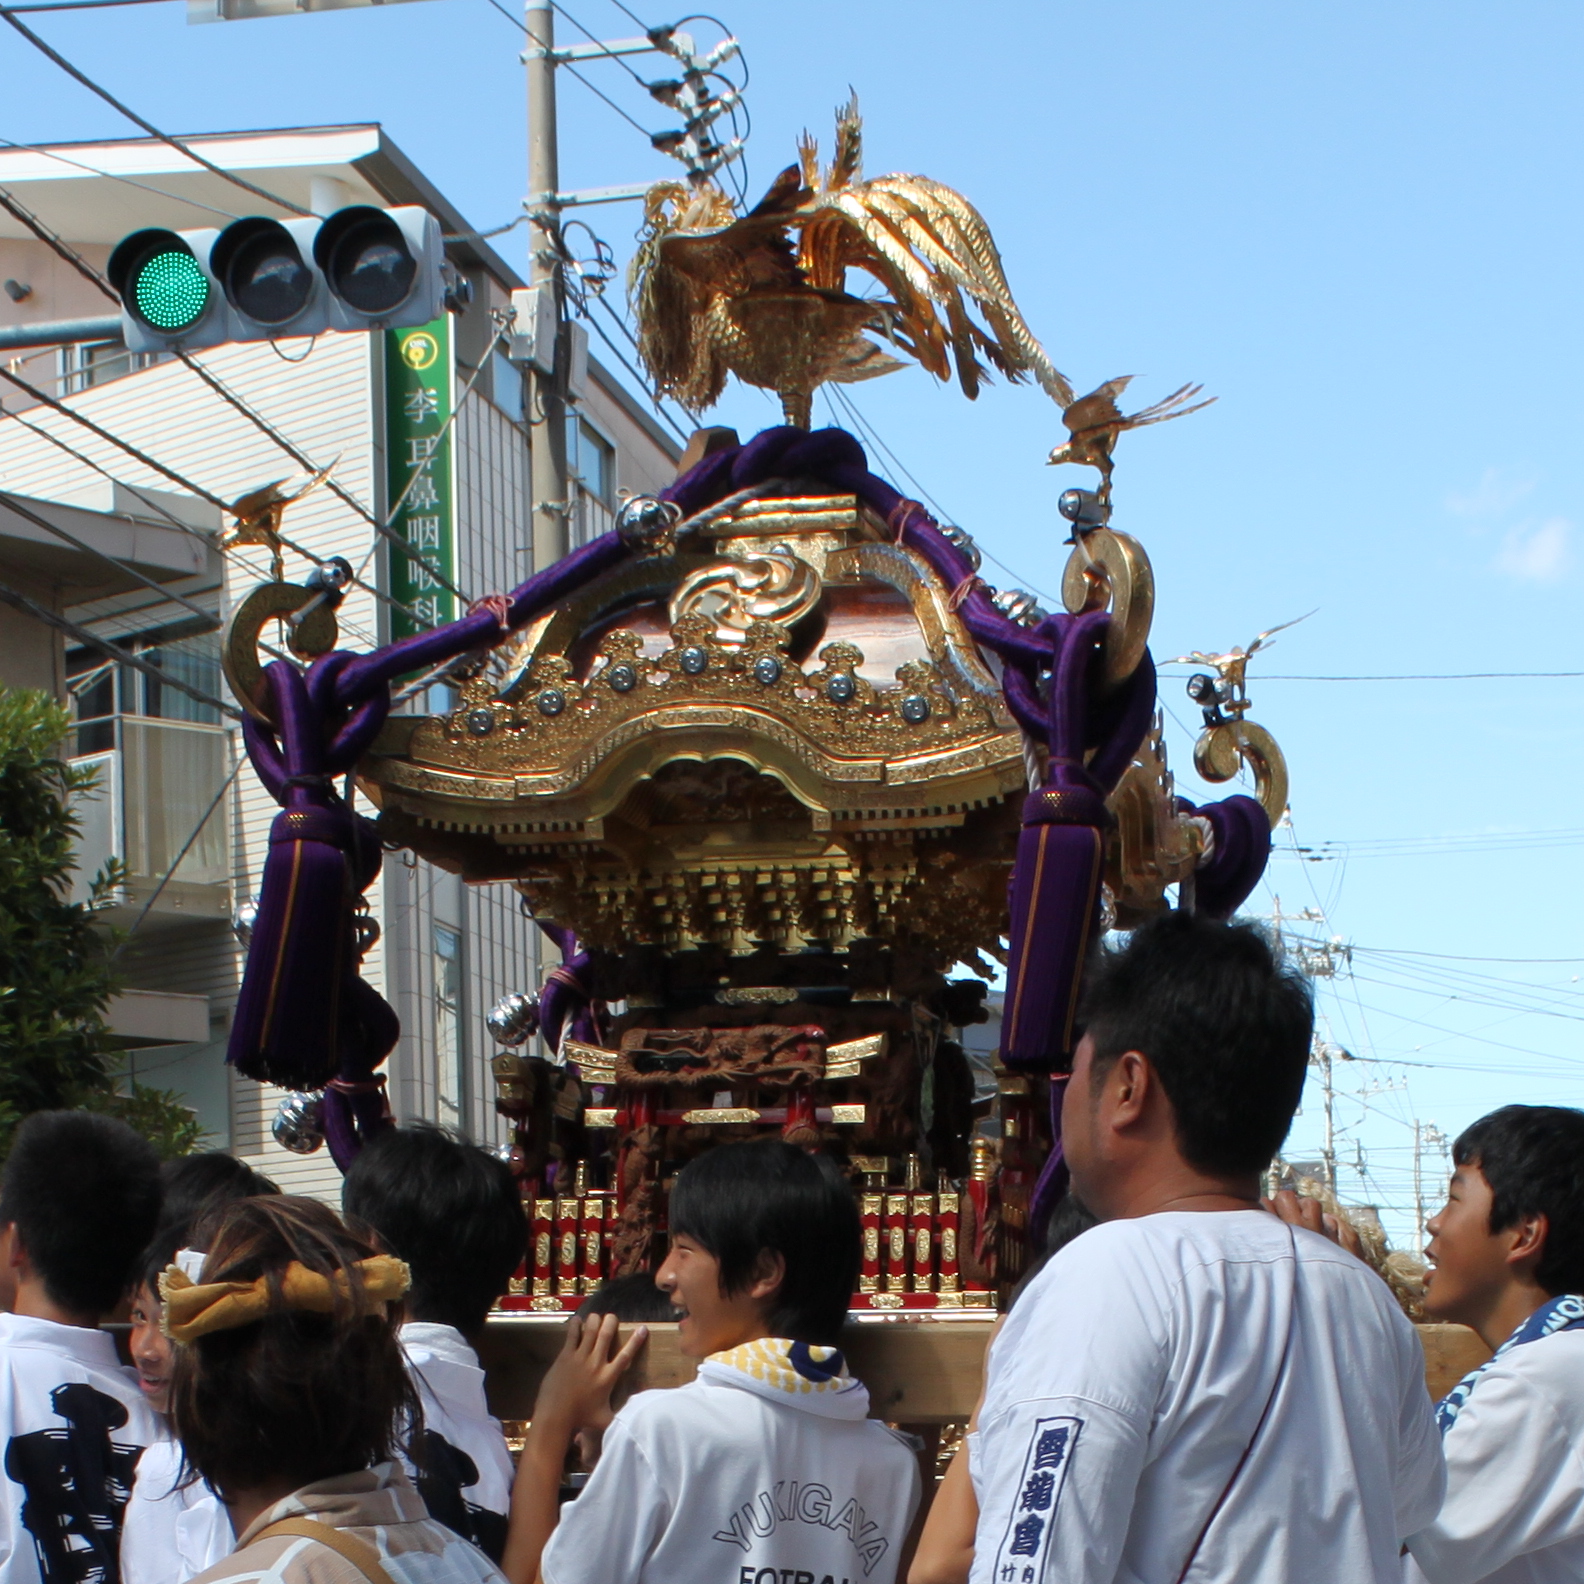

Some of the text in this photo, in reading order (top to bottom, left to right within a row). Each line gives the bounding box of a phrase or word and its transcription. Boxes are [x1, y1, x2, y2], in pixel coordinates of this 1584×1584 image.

[403, 388, 442, 632] 李耳鼻咽喉科
